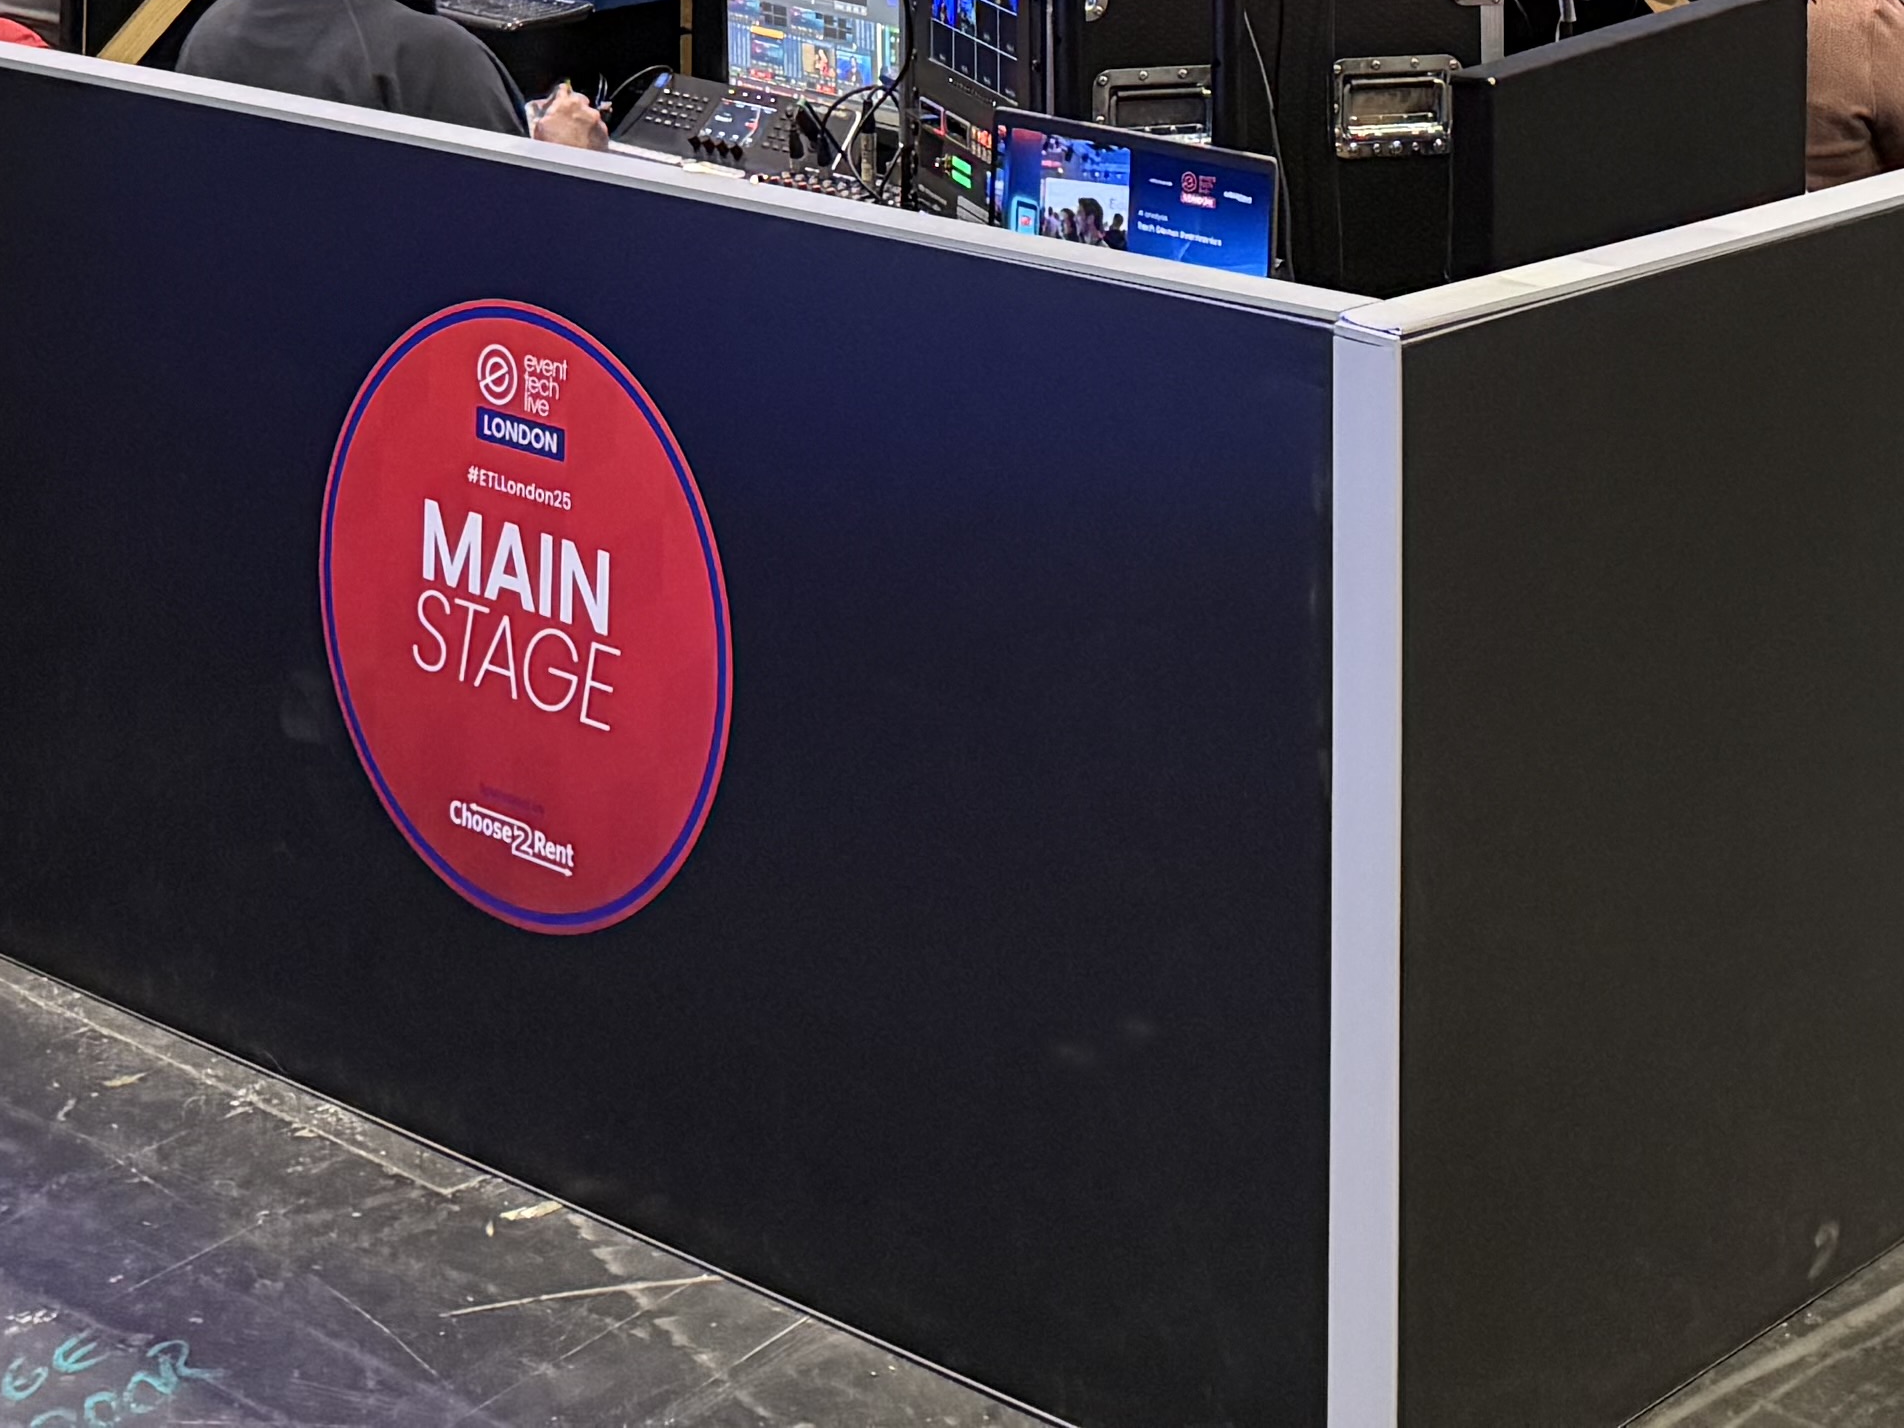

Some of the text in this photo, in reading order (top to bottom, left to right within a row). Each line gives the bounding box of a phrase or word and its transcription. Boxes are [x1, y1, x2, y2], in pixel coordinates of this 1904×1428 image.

[524, 354, 567, 381] event
[524, 371, 559, 400] tech
[524, 392, 549, 416] live
[483, 414, 558, 454] LONDON
[467, 465, 572, 511] #ETLLondon25
[423, 498, 610, 636] MAIN
[412, 590, 622, 732] STAGE
[449, 800, 574, 875] Choose2Rent
